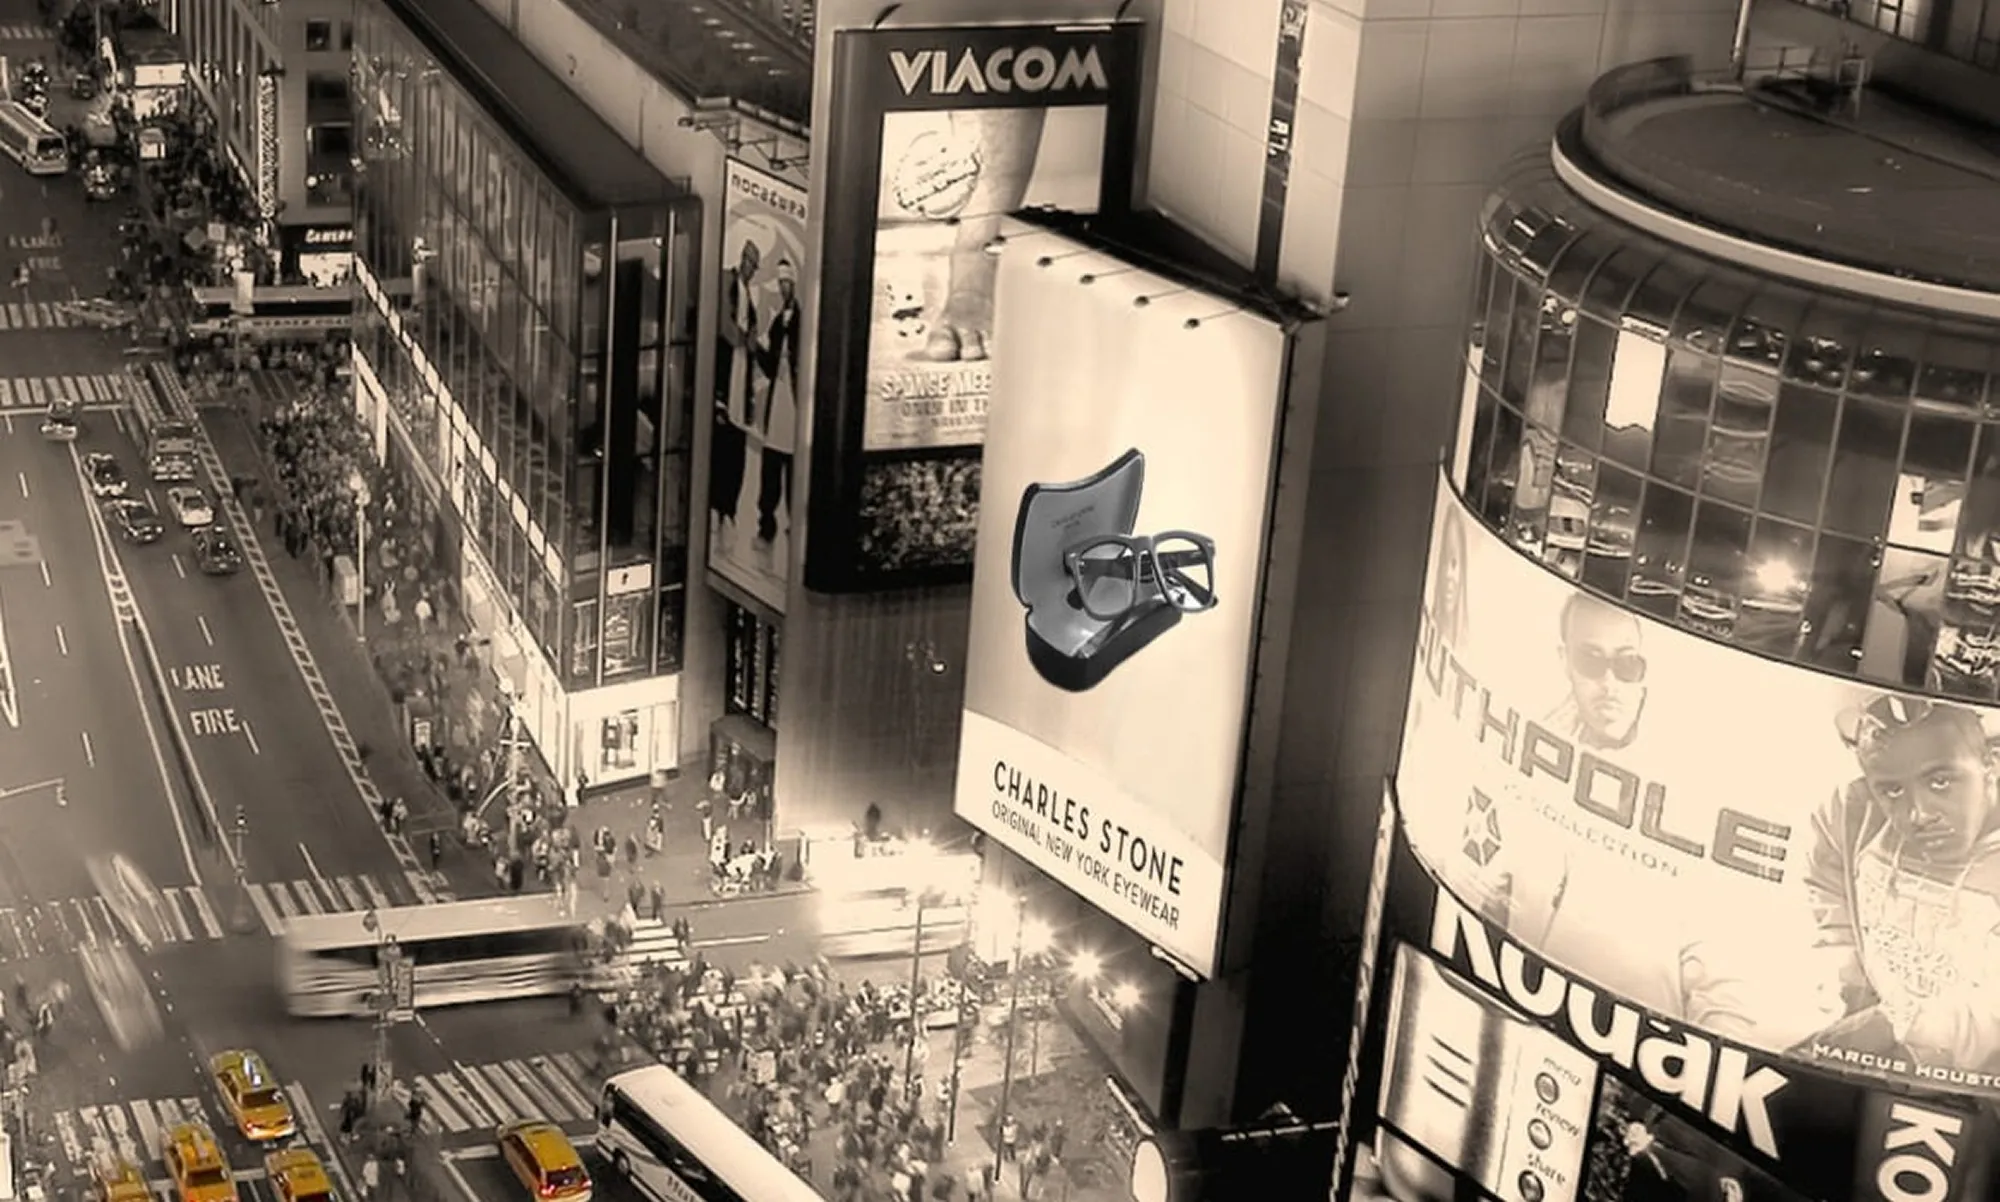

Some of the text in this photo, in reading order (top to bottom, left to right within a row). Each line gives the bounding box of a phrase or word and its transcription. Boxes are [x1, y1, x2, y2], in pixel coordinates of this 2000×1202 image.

[890, 46, 1108, 96] VIACOM
[171, 664, 224, 690] LANE
[190, 708, 240, 736] FIRE
[994, 760, 1184, 896] CHARLES STONE
[992, 799, 1180, 930] ORIGINAL NEW YORK EYEWEAR
[1811, 1043, 1907, 1072] MARCUS
